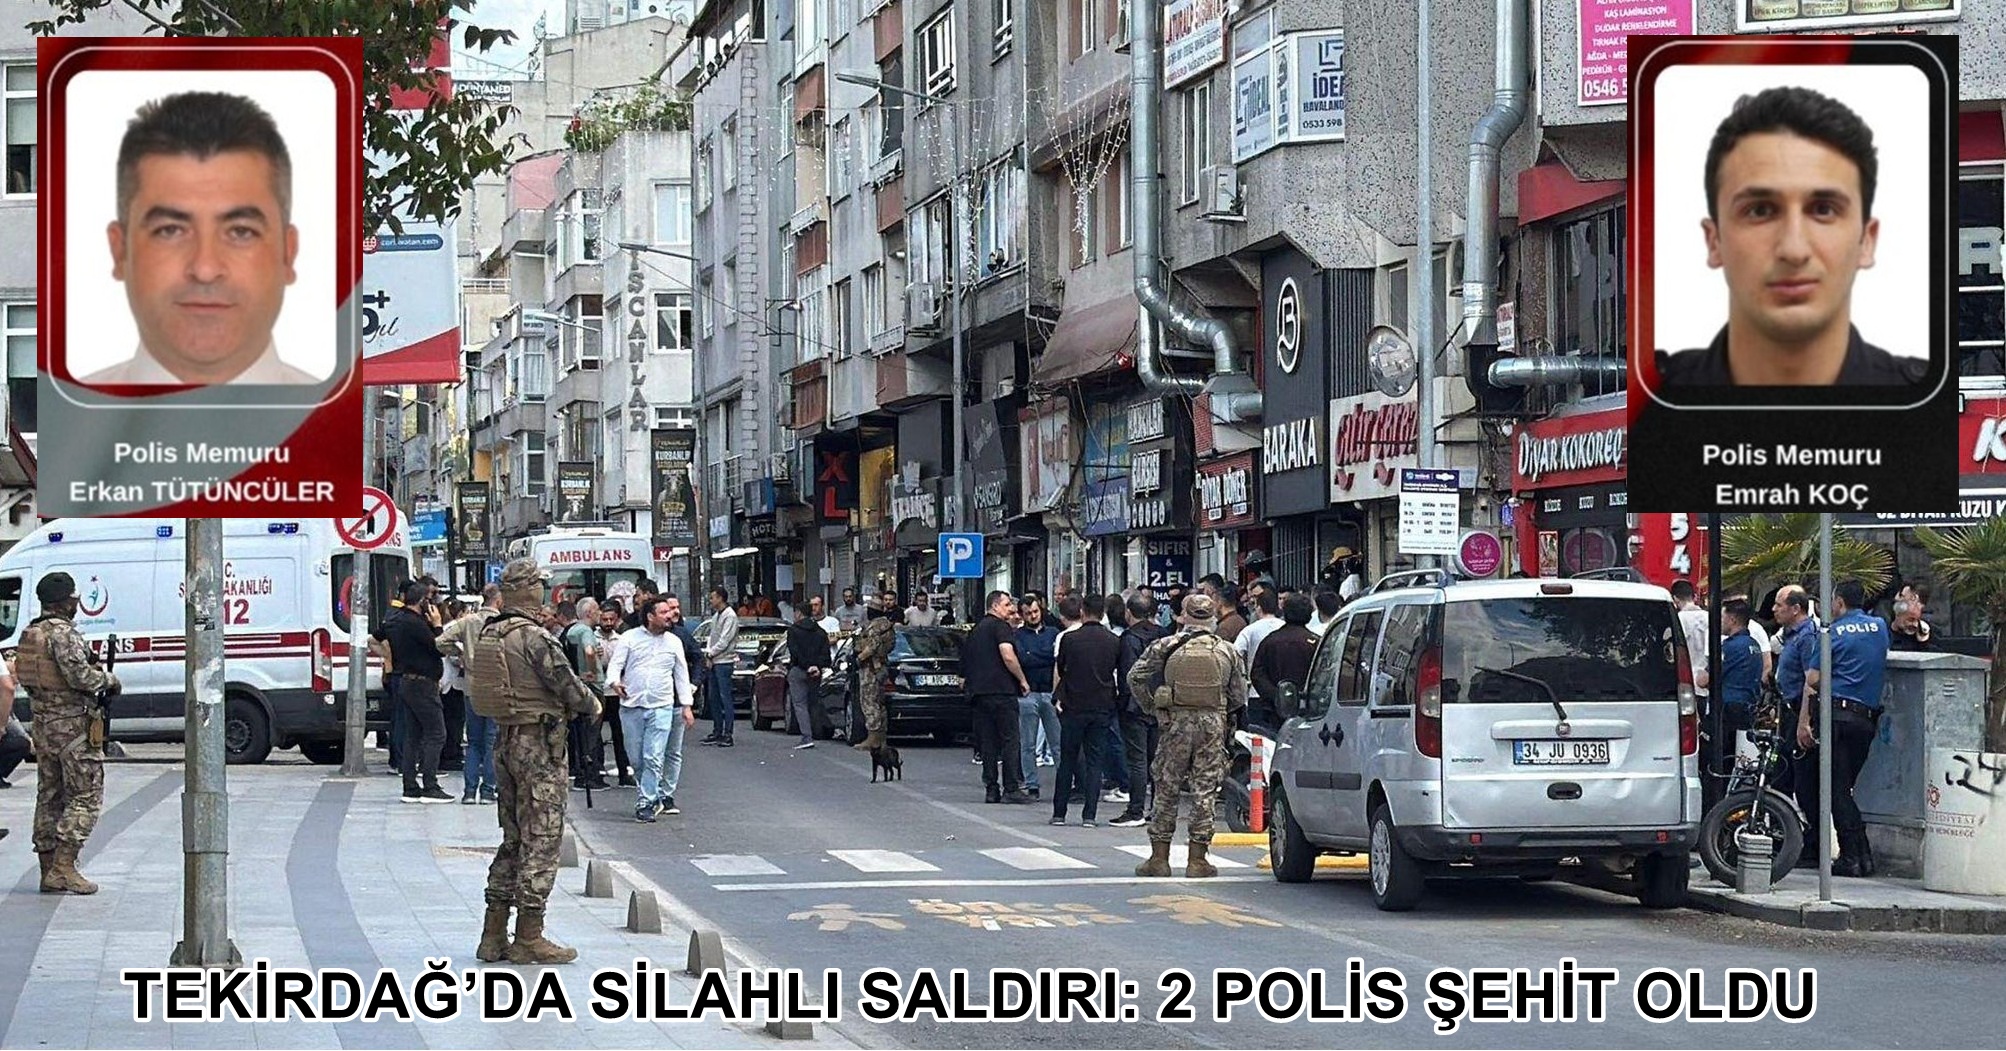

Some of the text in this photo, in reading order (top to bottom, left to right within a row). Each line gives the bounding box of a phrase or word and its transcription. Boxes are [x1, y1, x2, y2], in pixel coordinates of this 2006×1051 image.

[1584, 78, 1618, 98] 0546
[1303, 119, 1342, 129] 0533 598
[1264, 417, 1317, 474] BARAKA
[947, 537, 973, 570] P
[1147, 541, 1190, 556] SIFIR
[550, 550, 632, 564] AMBULANS
[223, 576, 272, 595] AKANLIĞI
[1150, 571, 1188, 587] 2.EL
[1836, 622, 1879, 636] POLIS
[1524, 743, 1607, 758] 34 JU 0936
